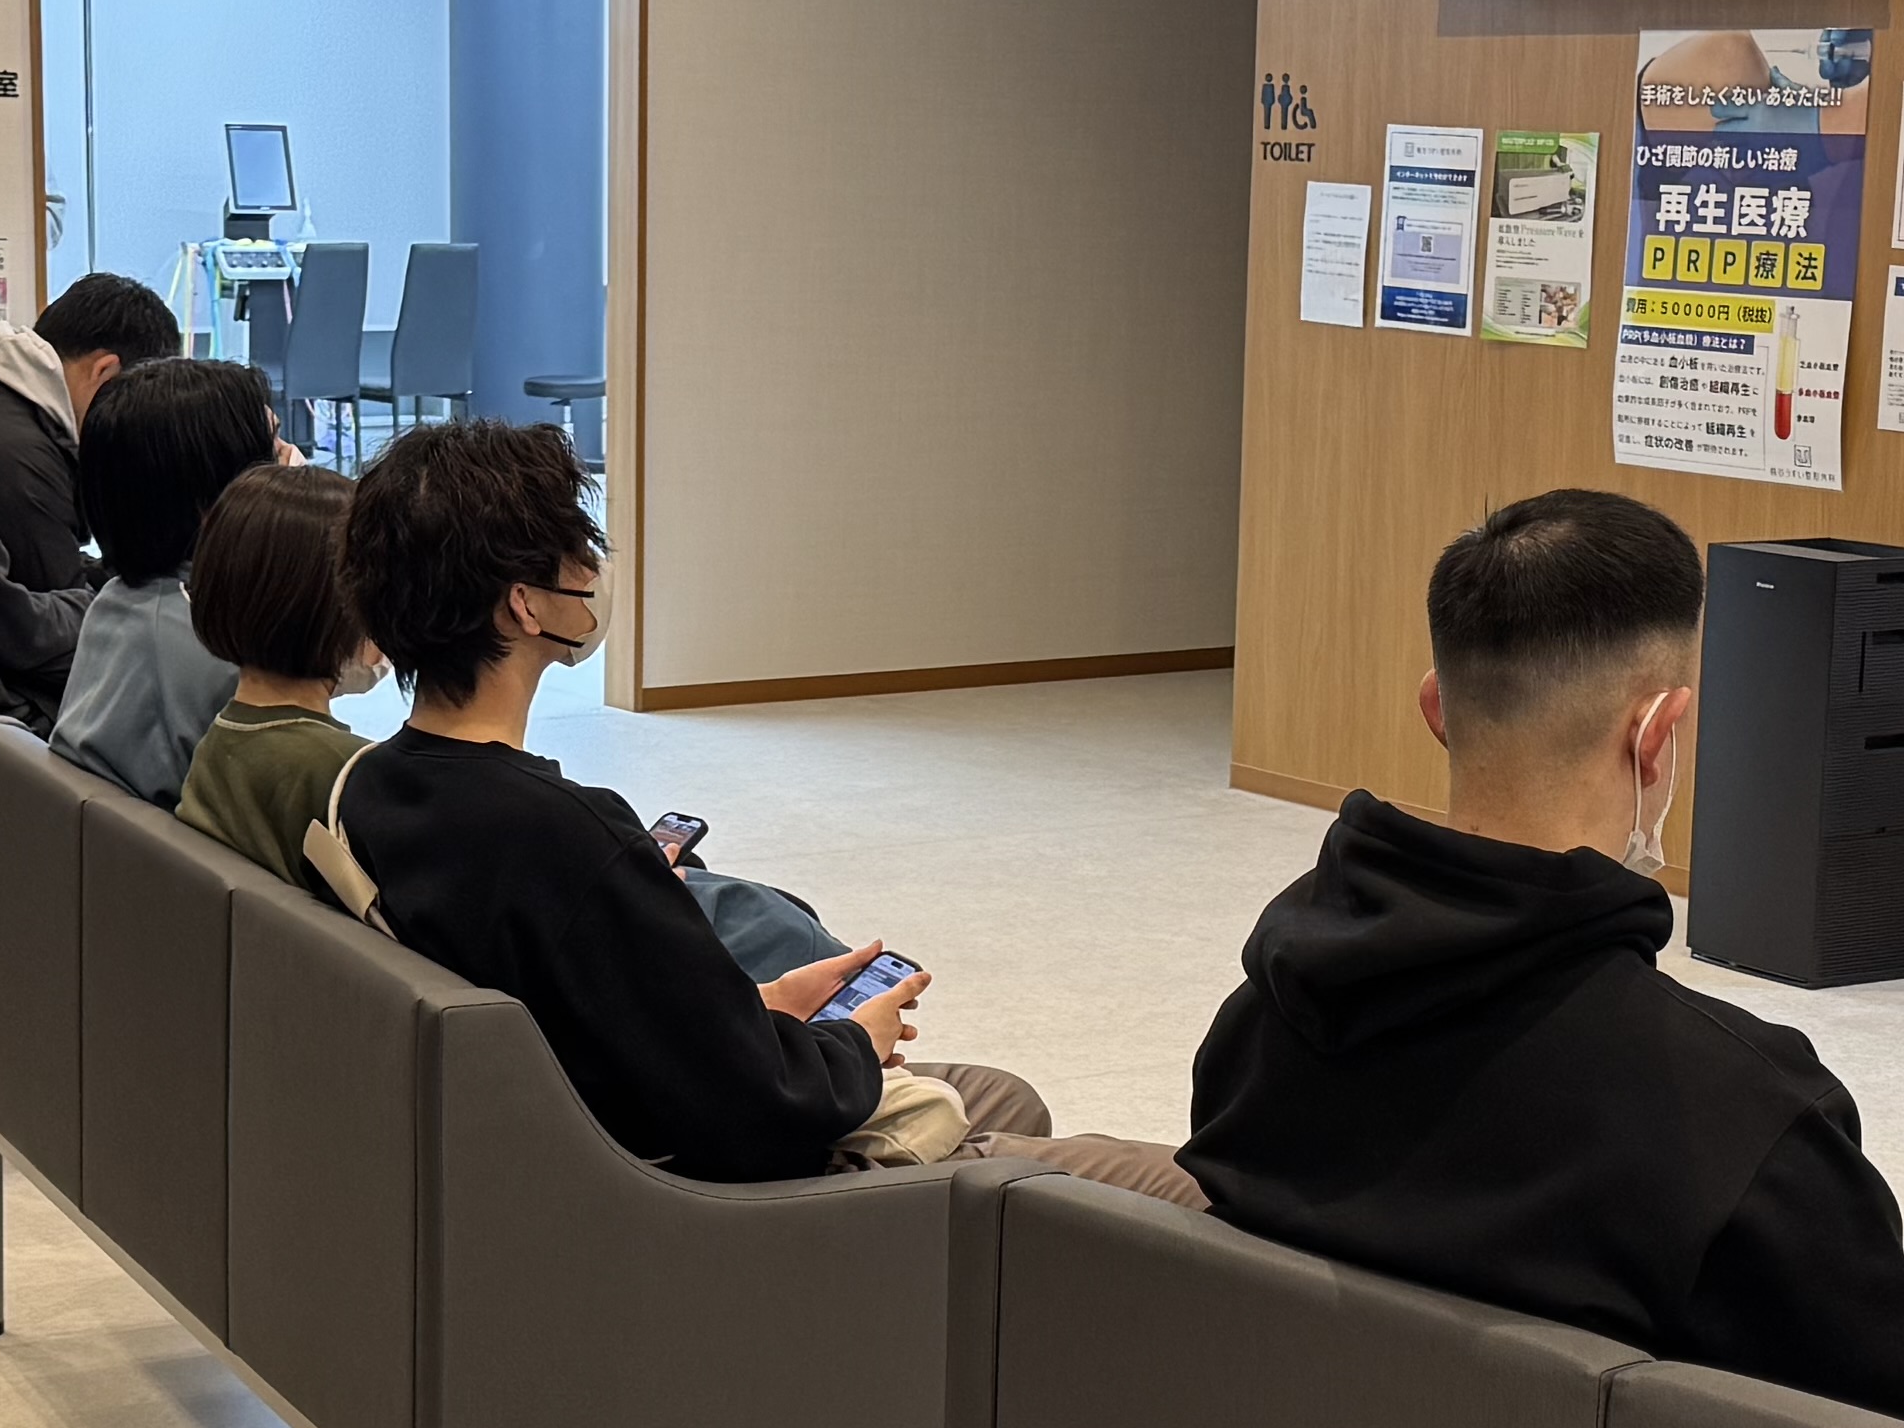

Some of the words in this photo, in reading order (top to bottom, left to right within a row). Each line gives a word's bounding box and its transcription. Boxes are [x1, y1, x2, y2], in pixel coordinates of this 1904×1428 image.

[1642, 85, 1762, 107] 手術をしたくない
[1766, 86, 1842, 107] あなたに!!
[1261, 142, 1315, 162] TOILET
[1636, 145, 1798, 171] ひざ関節の新しい治療
[1656, 184, 1811, 238] 再生医療
[1653, 247, 1818, 282] PRP療法
